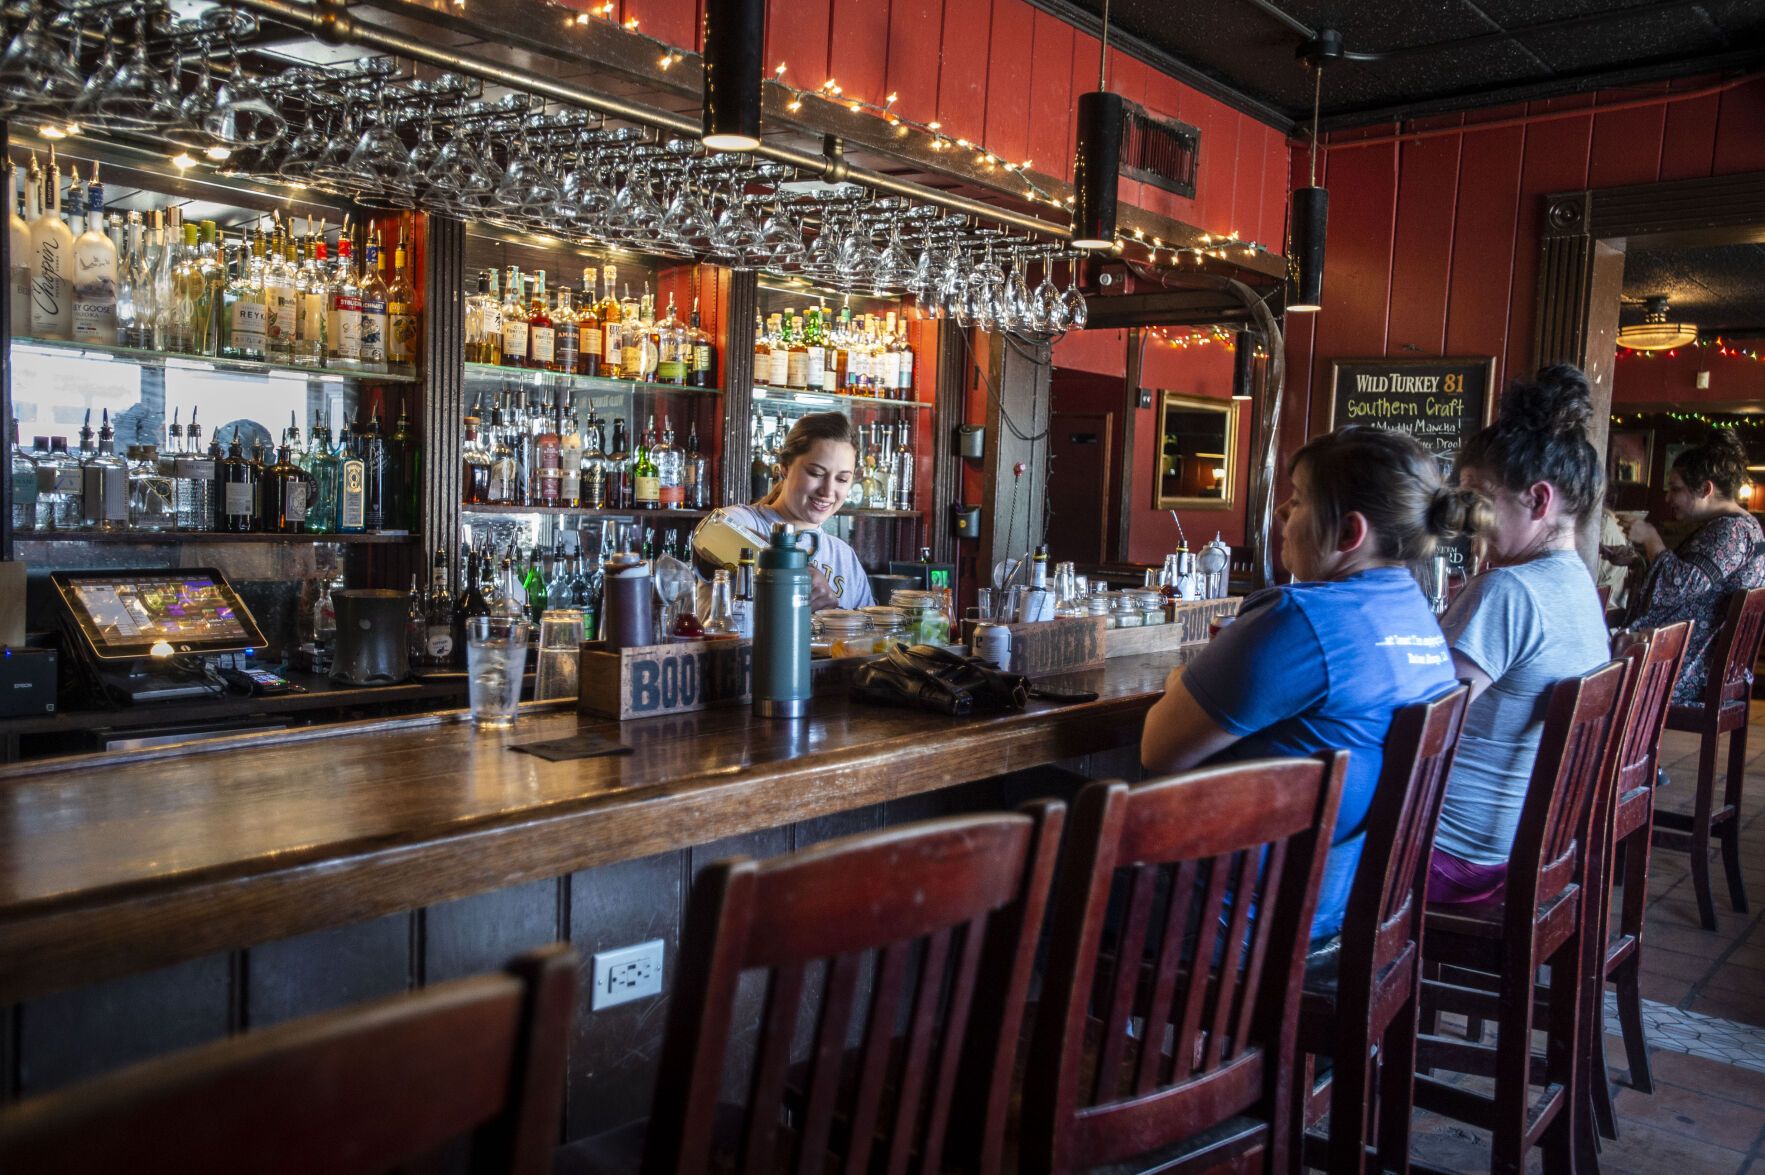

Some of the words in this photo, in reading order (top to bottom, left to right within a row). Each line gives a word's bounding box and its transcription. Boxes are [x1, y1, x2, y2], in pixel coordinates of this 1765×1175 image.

[32, 238, 65, 316] Chopin
[240, 310, 265, 320] REYK
[1356, 374, 1388, 392] WILD
[1390, 373, 1440, 393] TURKEY
[1443, 373, 1464, 392] 81
[1347, 397, 1418, 418] Southern
[1425, 396, 1464, 417] Craft
[1436, 436, 1461, 449] Drool
